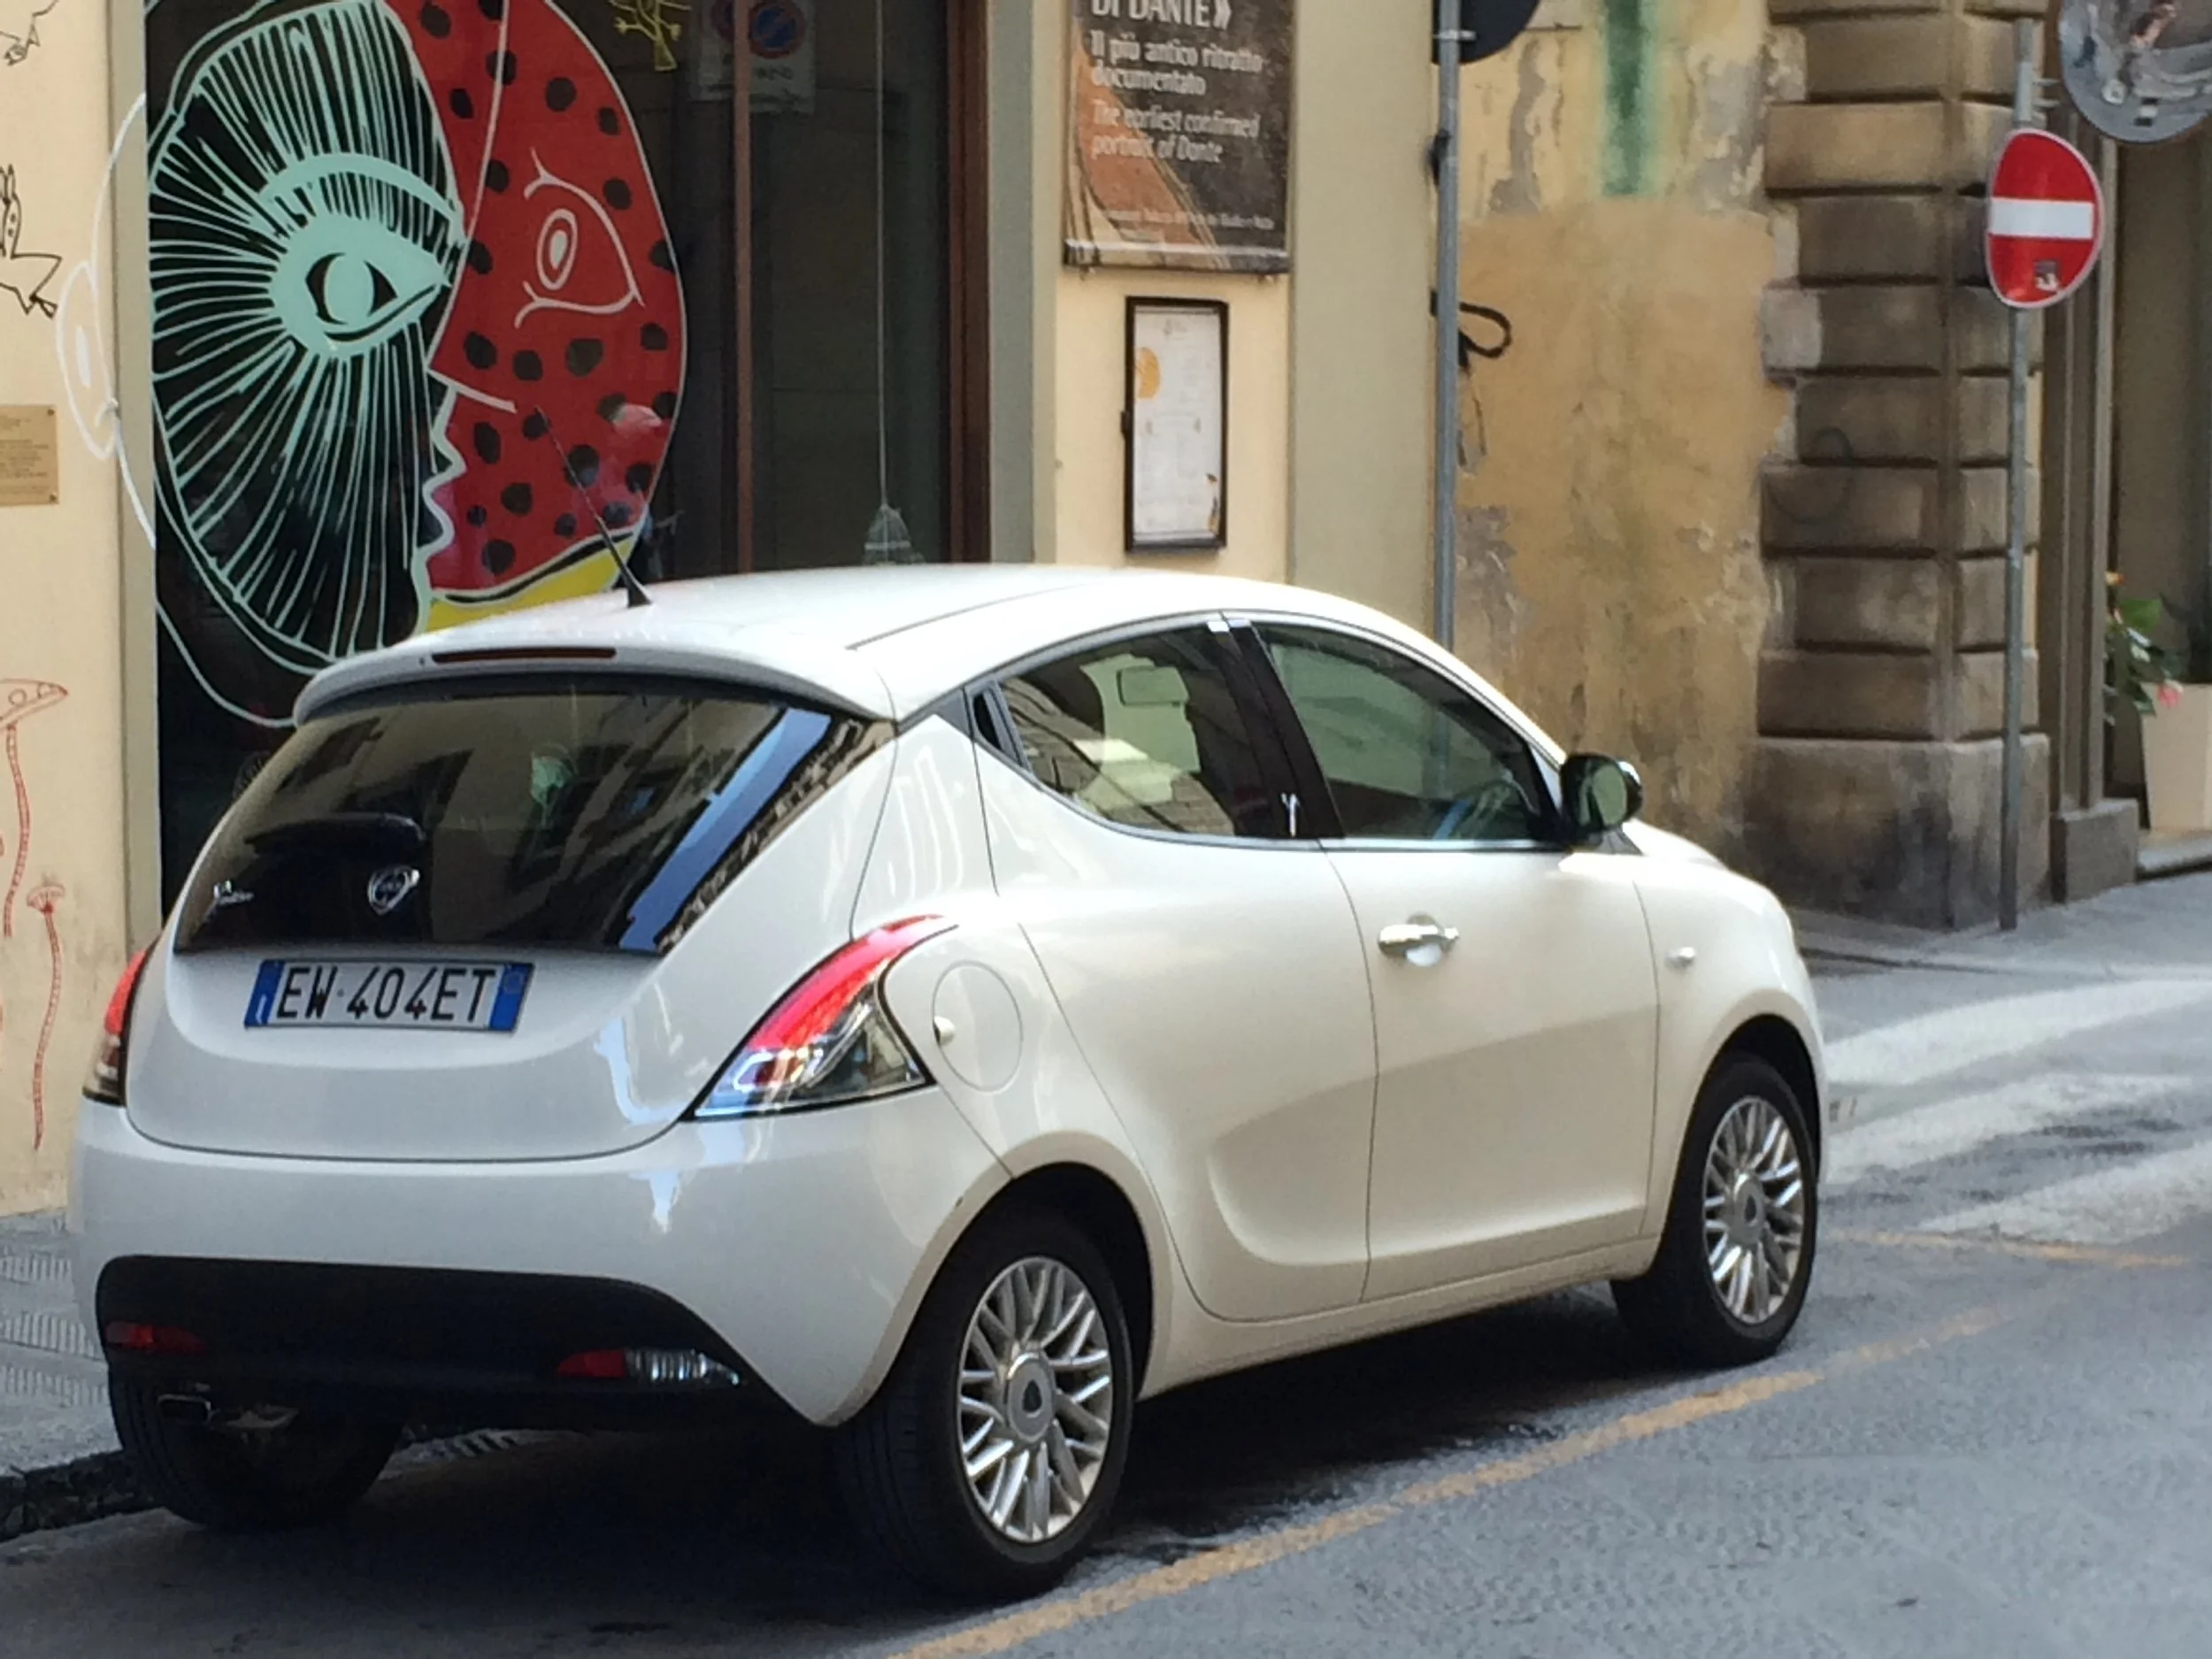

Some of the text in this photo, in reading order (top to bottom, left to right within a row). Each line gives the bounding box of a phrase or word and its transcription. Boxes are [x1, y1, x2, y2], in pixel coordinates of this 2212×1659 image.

[1144, 39, 1199, 67] antico
[1092, 98, 1120, 127] The
[1091, 133, 1224, 163] portrait of Dante
[276, 965, 338, 1020] EW
[346, 965, 496, 1023] 404ET
